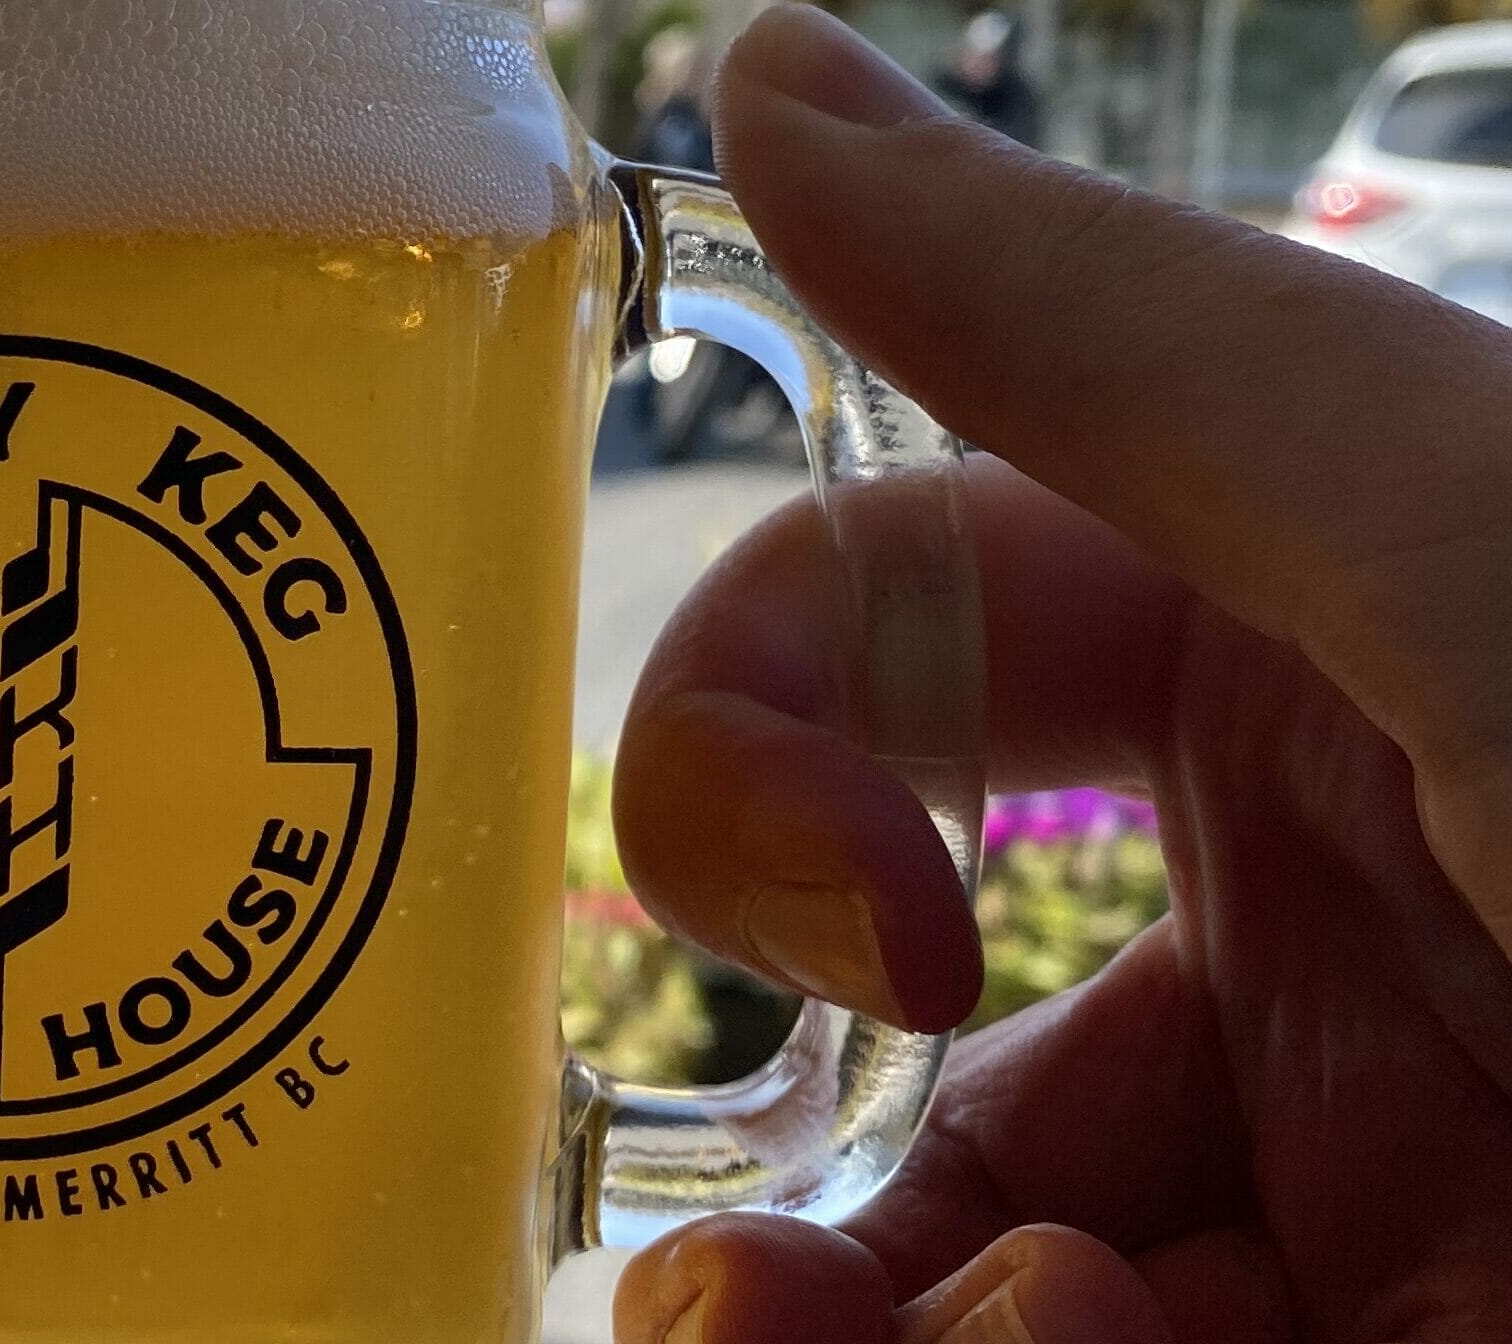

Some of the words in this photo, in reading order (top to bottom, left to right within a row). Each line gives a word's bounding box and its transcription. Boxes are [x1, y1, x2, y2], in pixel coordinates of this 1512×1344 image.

[135, 424, 348, 642] KEG
[39, 817, 330, 1082] HOUSE
[3, 1101, 260, 1223] MERRITT
[273, 1035, 351, 1111] BC
